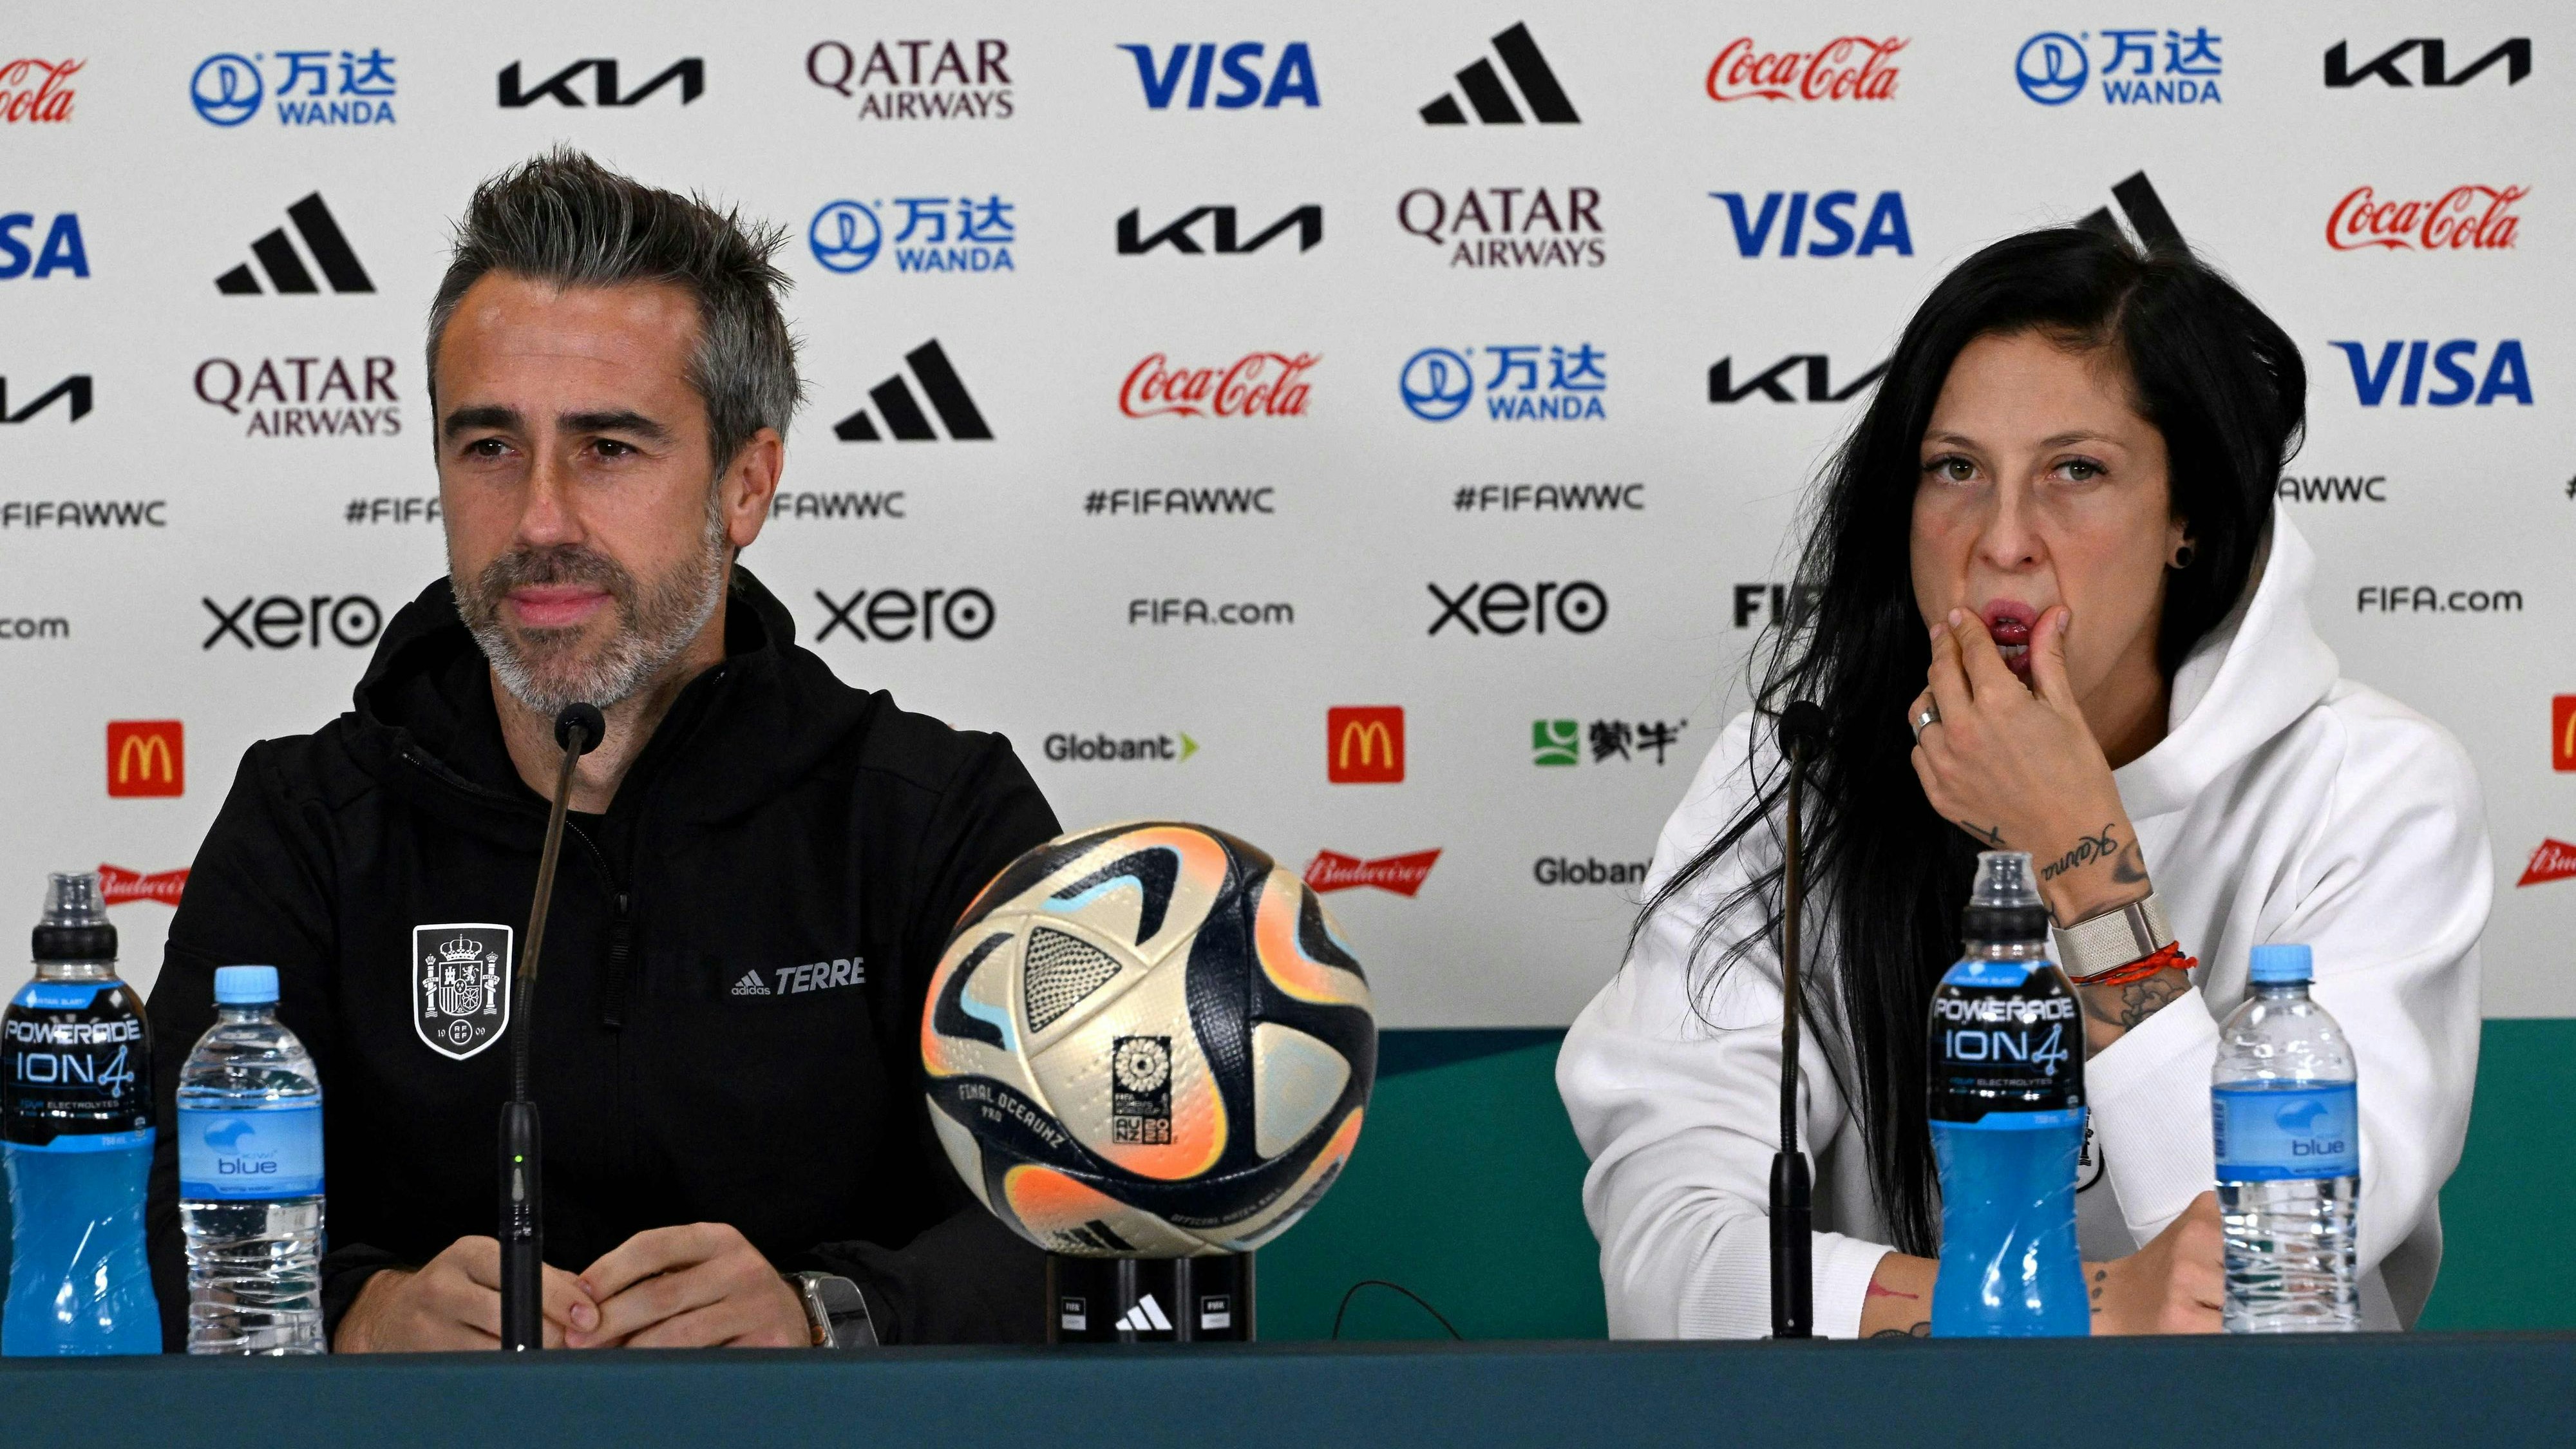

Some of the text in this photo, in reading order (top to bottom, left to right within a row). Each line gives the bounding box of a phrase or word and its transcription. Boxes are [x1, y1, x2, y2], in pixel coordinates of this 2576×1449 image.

[2099, 26, 2222, 76] 万达
[274, 47, 397, 97] 万达
[804, 39, 1013, 97] QATAR
[1116, 41, 1321, 110] VISA
[859, 90, 1014, 120] AIRWAYS
[2102, 79, 2222, 105] WANDA
[277, 100, 396, 126] WANDA
[893, 194, 1015, 245] 万达
[1397, 187, 1604, 243] QATAR
[1709, 189, 1914, 259] VISA
[895, 247, 1014, 272] WANDA
[1450, 238, 1605, 267] AIRWAYS
[1484, 343, 1607, 392] 万达
[2327, 338, 2534, 408] VISA
[193, 356, 400, 414] QATAR
[247, 407, 401, 437] AIRWAYS
[1486, 393, 1606, 421] WANDA
[1084, 487, 1274, 515] #FIFAWWC
[1454, 483, 1644, 511] #FIFAWWC
[1128, 598, 1294, 625] FIFA.com
[1426, 580, 1609, 637] xero
[2357, 585, 2523, 613] FIFA.com
[202, 594, 381, 650] xero
[814, 587, 996, 643] xero
[1043, 734, 1175, 762] Globant
[1533, 857, 1653, 886] Globan
[731, 956, 866, 995] adidas TERRE
[1934, 998, 2075, 1023] POWERADE
[5, 1019, 142, 1045] POWERADE
[2292, 1139, 2345, 1156] blue
[219, 1157, 277, 1175] blue
